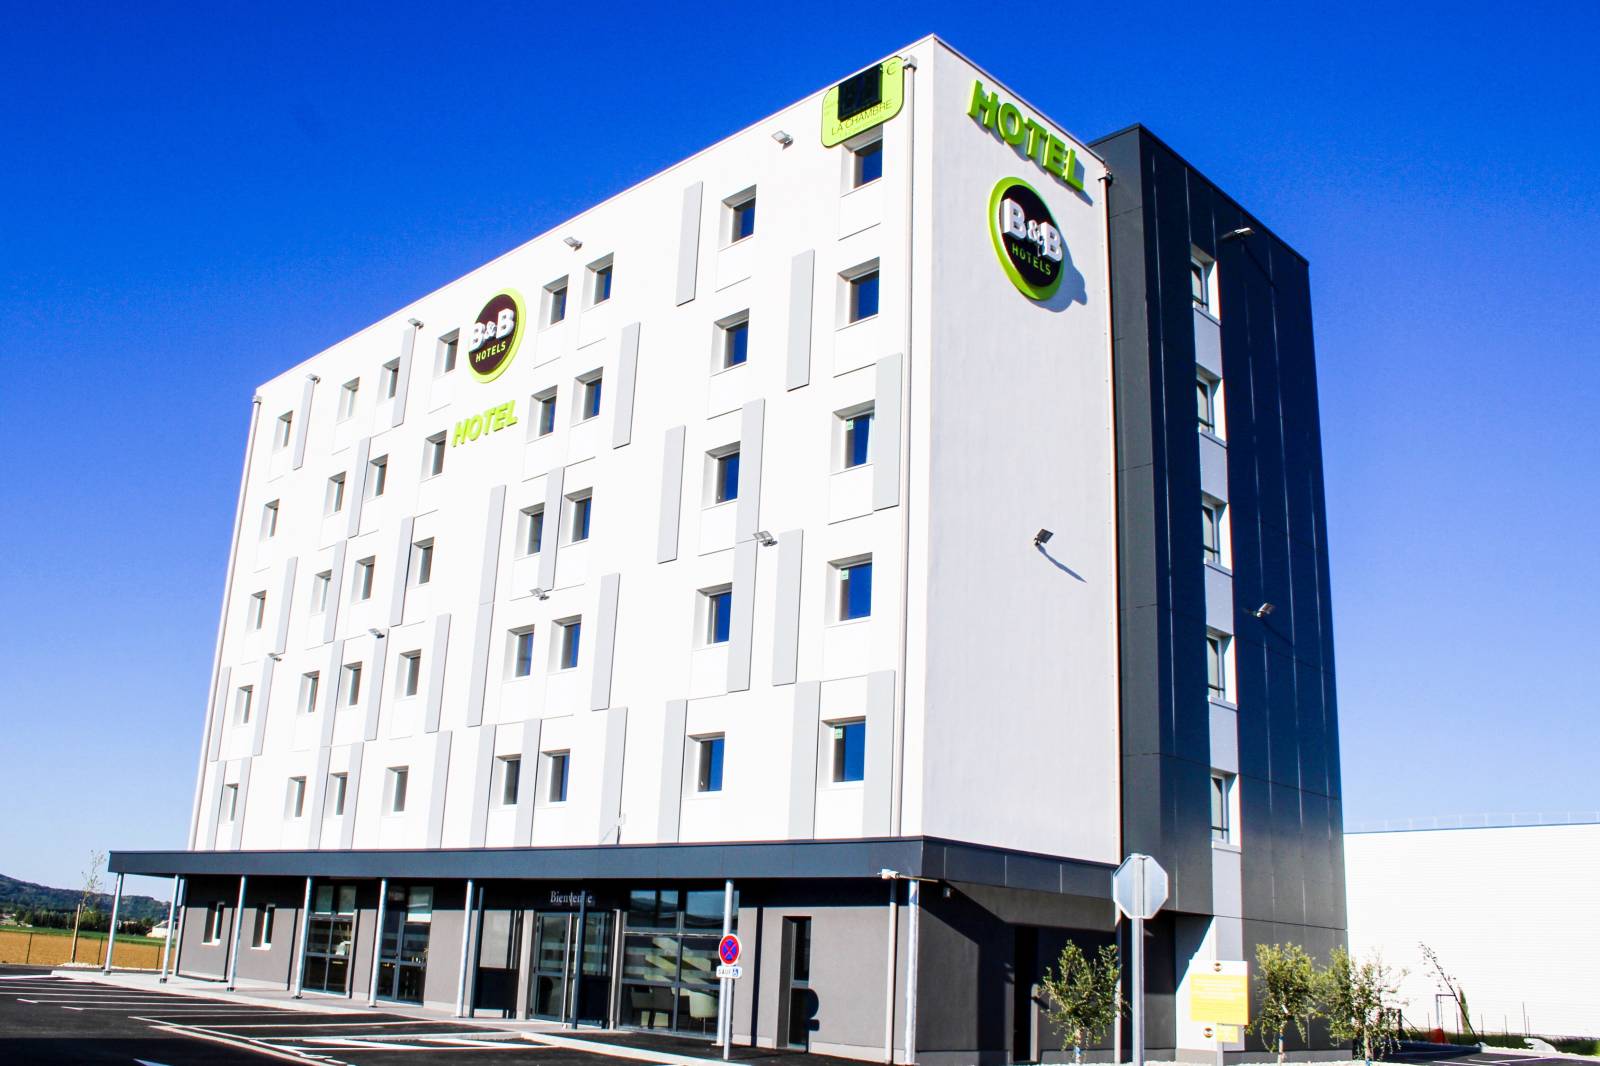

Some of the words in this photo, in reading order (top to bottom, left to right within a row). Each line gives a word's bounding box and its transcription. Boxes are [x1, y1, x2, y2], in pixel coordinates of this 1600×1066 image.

[831, 123, 843, 136] LA
[967, 79, 1084, 192] HOTEL
[1002, 197, 1063, 262] B&B
[1011, 244, 1051, 276] HOTELS
[469, 308, 515, 352] B&B
[475, 341, 506, 363] HOTELS
[452, 400, 518, 448] HOTEL
